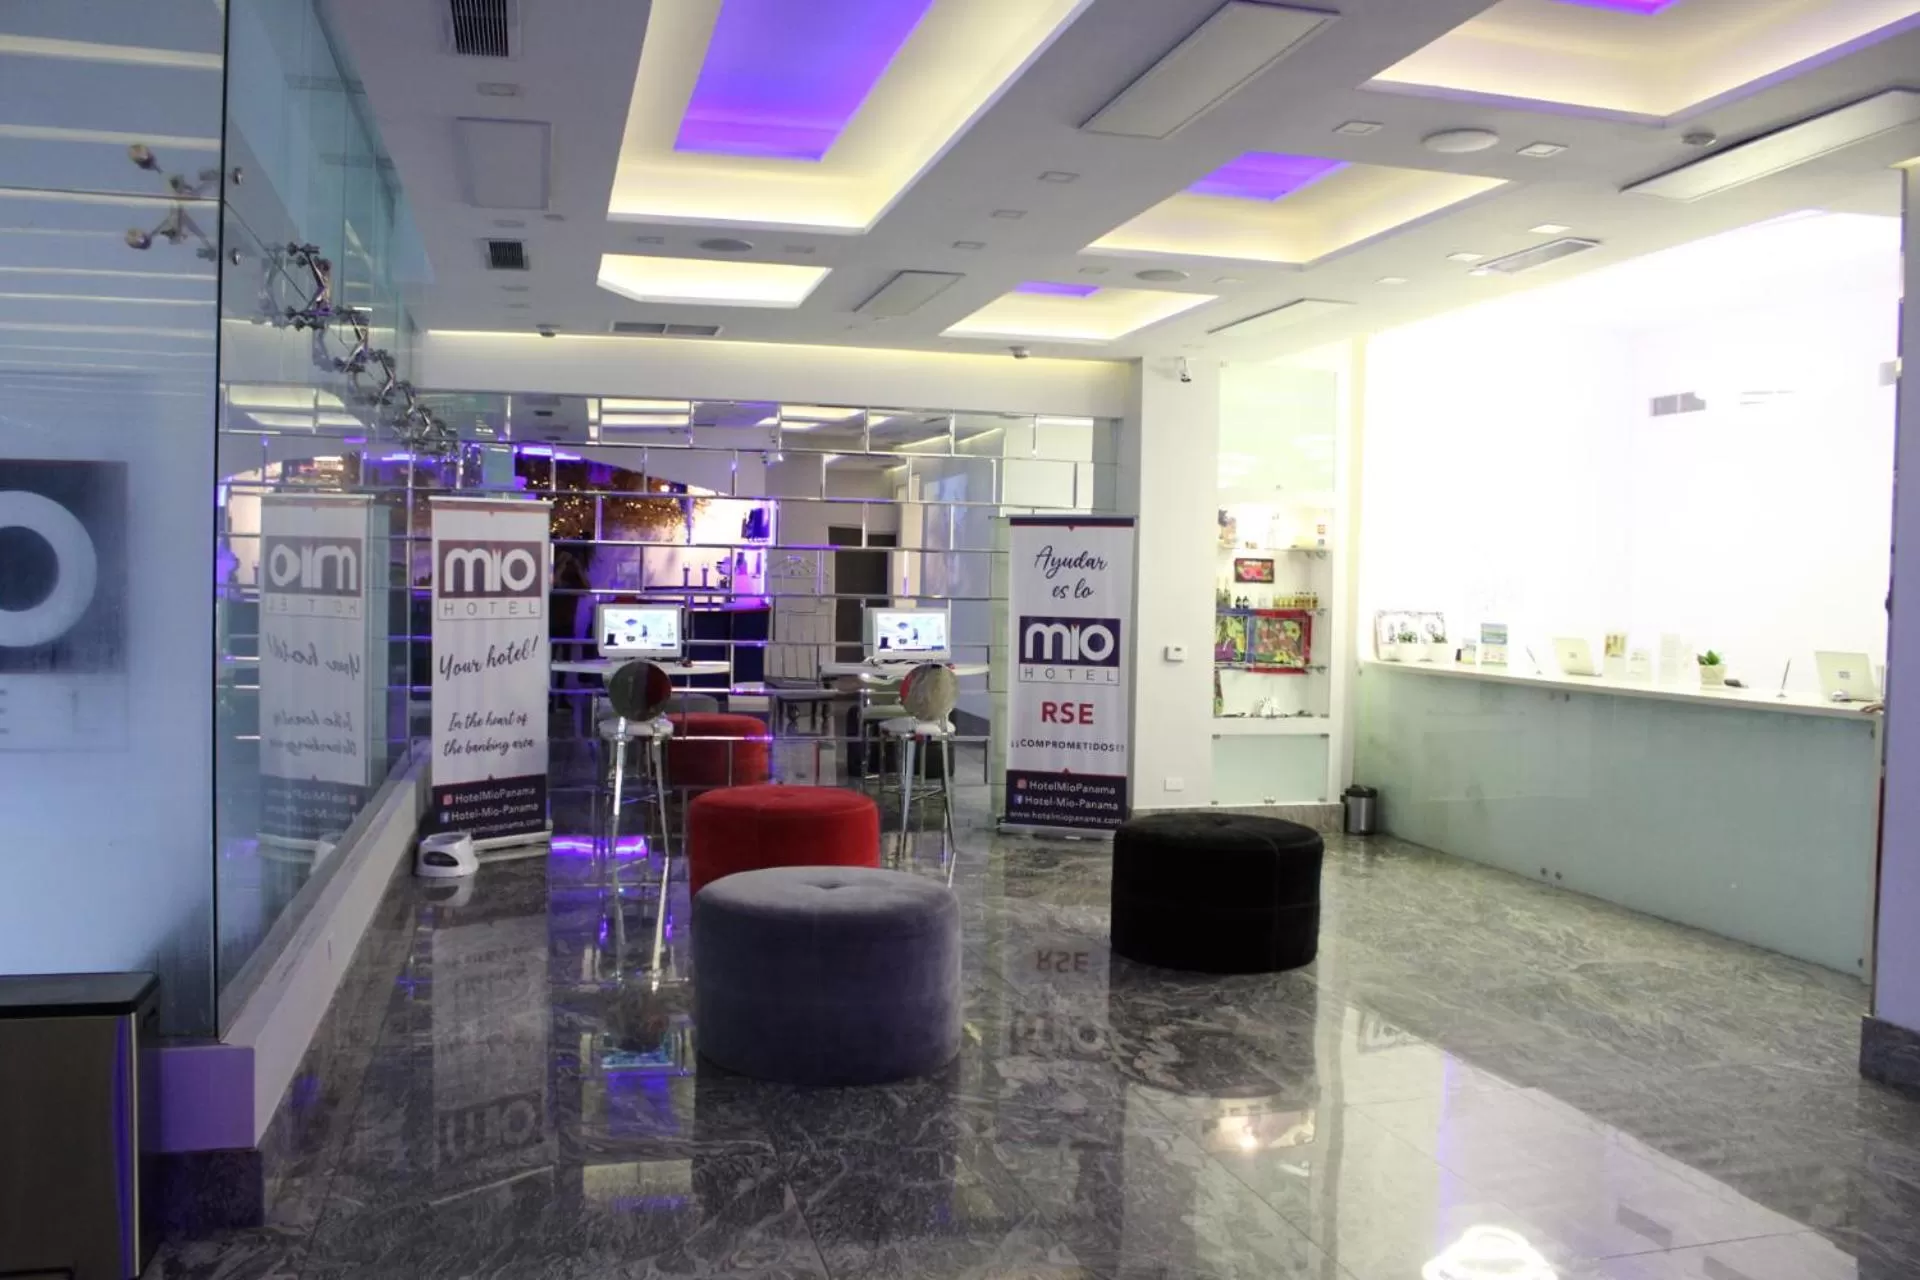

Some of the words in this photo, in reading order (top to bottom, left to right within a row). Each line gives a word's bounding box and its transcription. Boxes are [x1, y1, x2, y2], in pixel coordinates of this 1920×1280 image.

[1033, 545, 1107, 579] Ayudar
[1052, 584, 1069, 599] es
[1074, 578, 1094, 599] lo
[444, 601, 538, 616] HOTEL
[439, 653, 482, 681] Your
[486, 635, 539, 668] hotel!
[1024, 667, 1114, 682] HOTEL
[448, 712, 462, 732] In
[464, 711, 482, 729] the
[484, 710, 514, 726] heart
[516, 712, 528, 726] of
[1041, 701, 1094, 725] RSE
[443, 738, 462, 757] the
[464, 737, 509, 756] banking
[512, 739, 534, 749] area
[455, 788, 536, 805] HotelMioPanama
[1029, 780, 1116, 795] HotelMioPanama
[451, 803, 539, 821] Hotel-Mio-Panama
[1024, 796, 1119, 810] Hotel-Mio-Panama
[1009, 810, 1123, 825] www.hotelmiopanama.com
